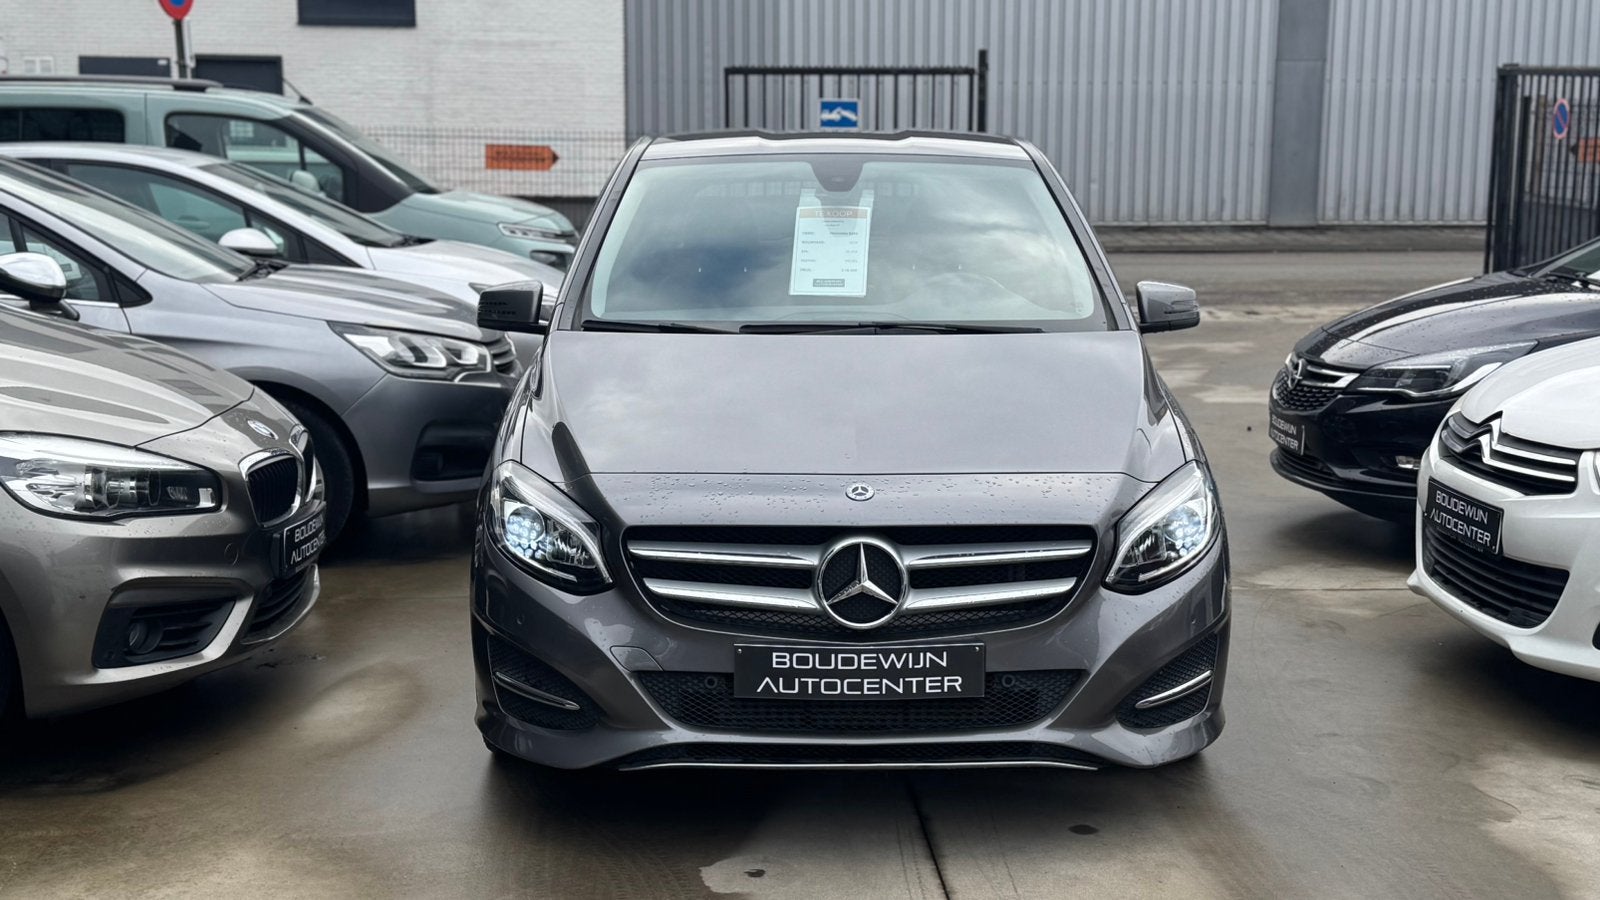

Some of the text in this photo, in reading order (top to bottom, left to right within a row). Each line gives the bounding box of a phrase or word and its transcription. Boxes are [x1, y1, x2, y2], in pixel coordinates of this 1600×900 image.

[1436, 490, 1488, 524] BOUDEWIJN
[1429, 508, 1491, 546] AUTOCENTER
[770, 651, 948, 670] BOUDEWIJN
[756, 676, 963, 694] AUTOCENTER
